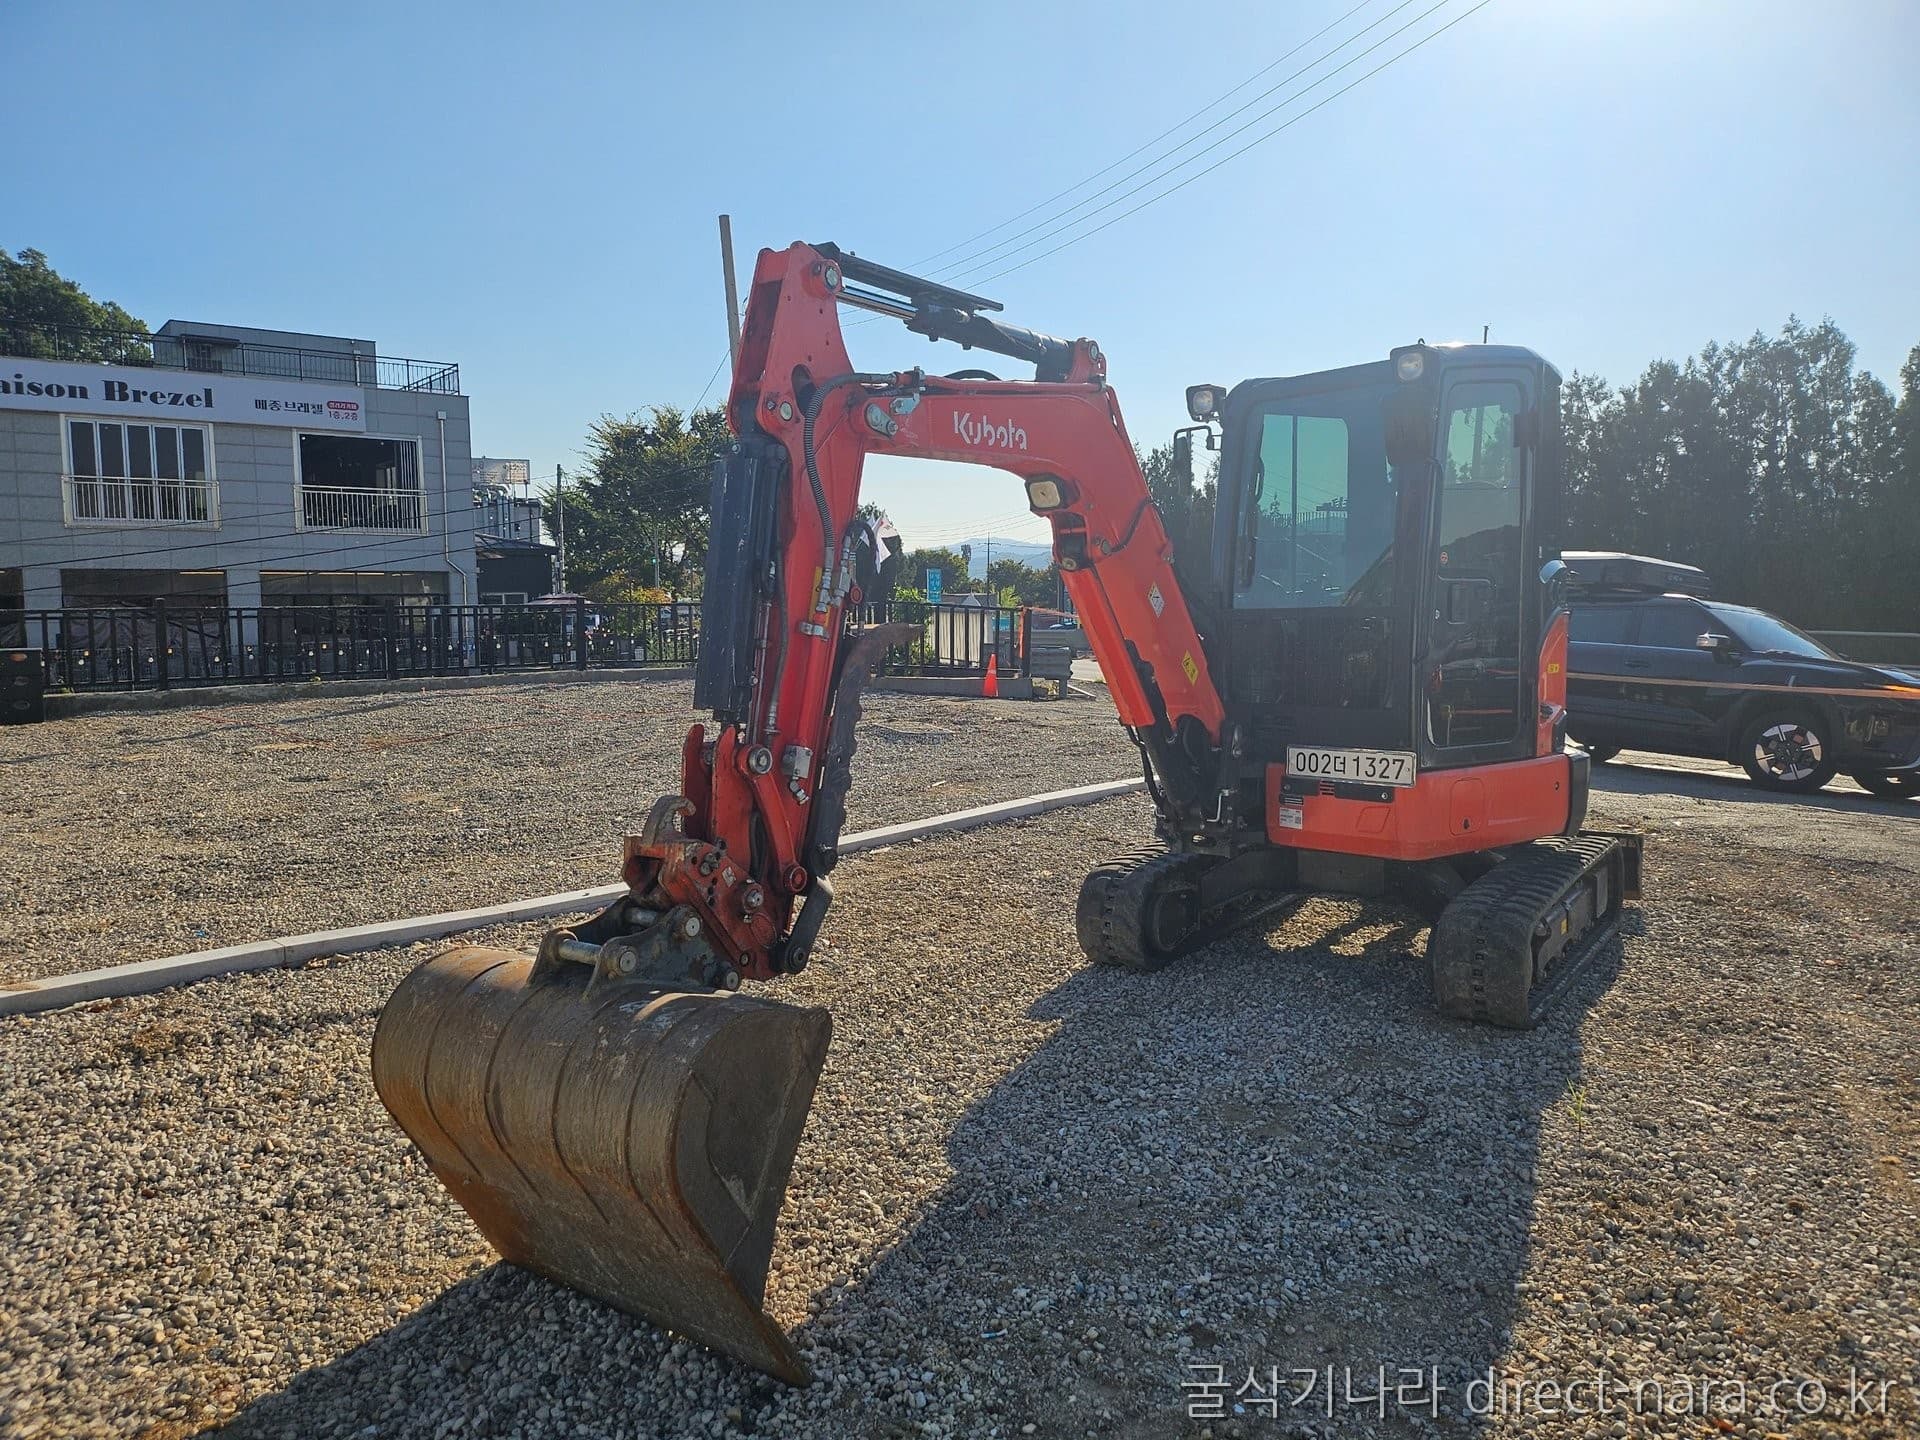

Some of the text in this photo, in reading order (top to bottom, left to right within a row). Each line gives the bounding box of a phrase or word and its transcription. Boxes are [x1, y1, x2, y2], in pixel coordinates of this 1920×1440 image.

[101, 379, 215, 408] Brezel
[254, 399, 282, 411] 메종
[953, 410, 1028, 450] Kubota
